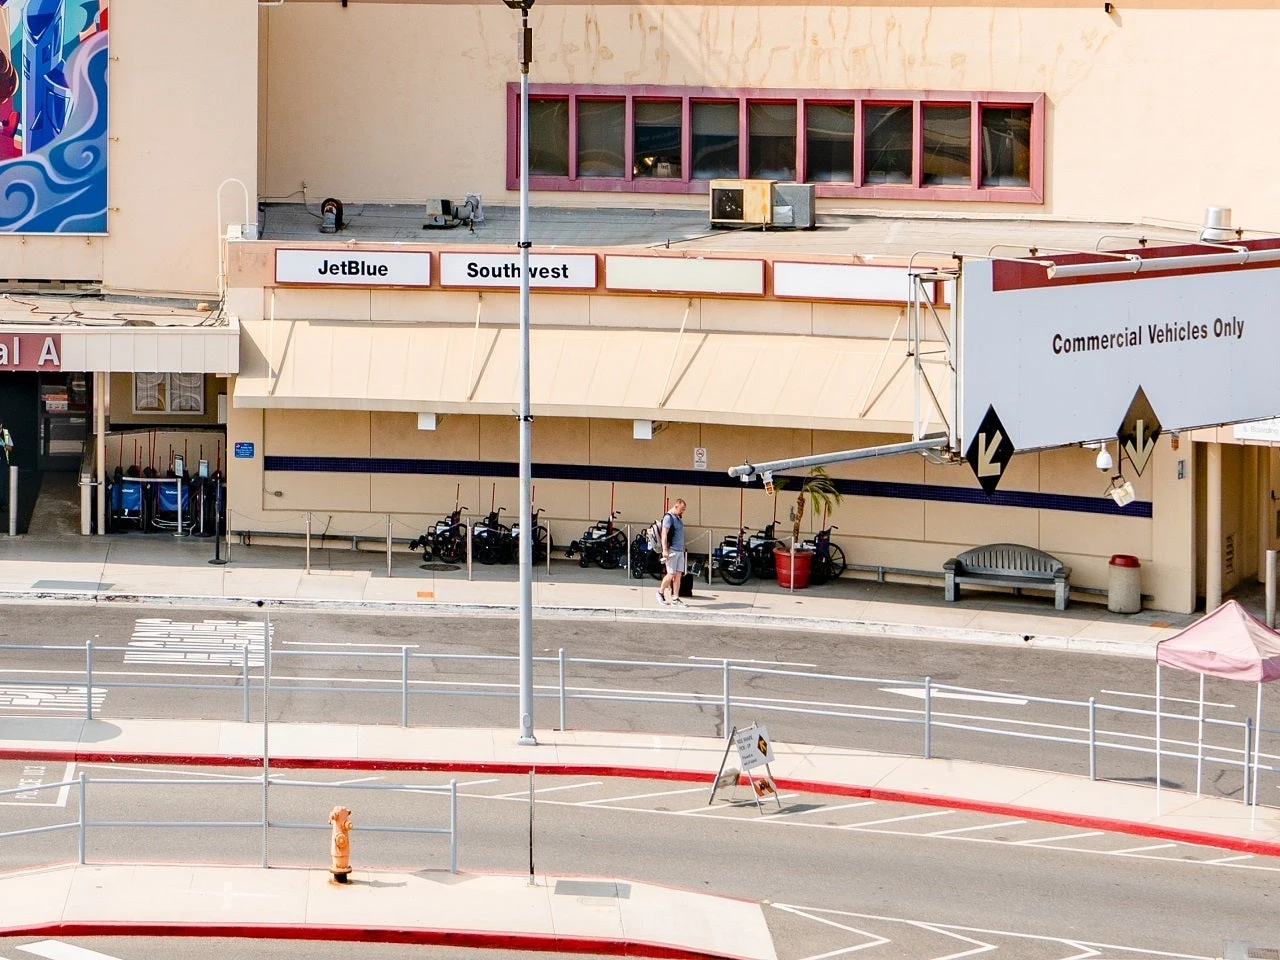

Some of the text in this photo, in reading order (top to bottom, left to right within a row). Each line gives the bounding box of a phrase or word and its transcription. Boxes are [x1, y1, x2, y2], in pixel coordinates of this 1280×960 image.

[318, 259, 388, 278] JetBlue
[1052, 315, 1245, 355] Commercial Vehicles Only
[37, 336, 61, 366] A
